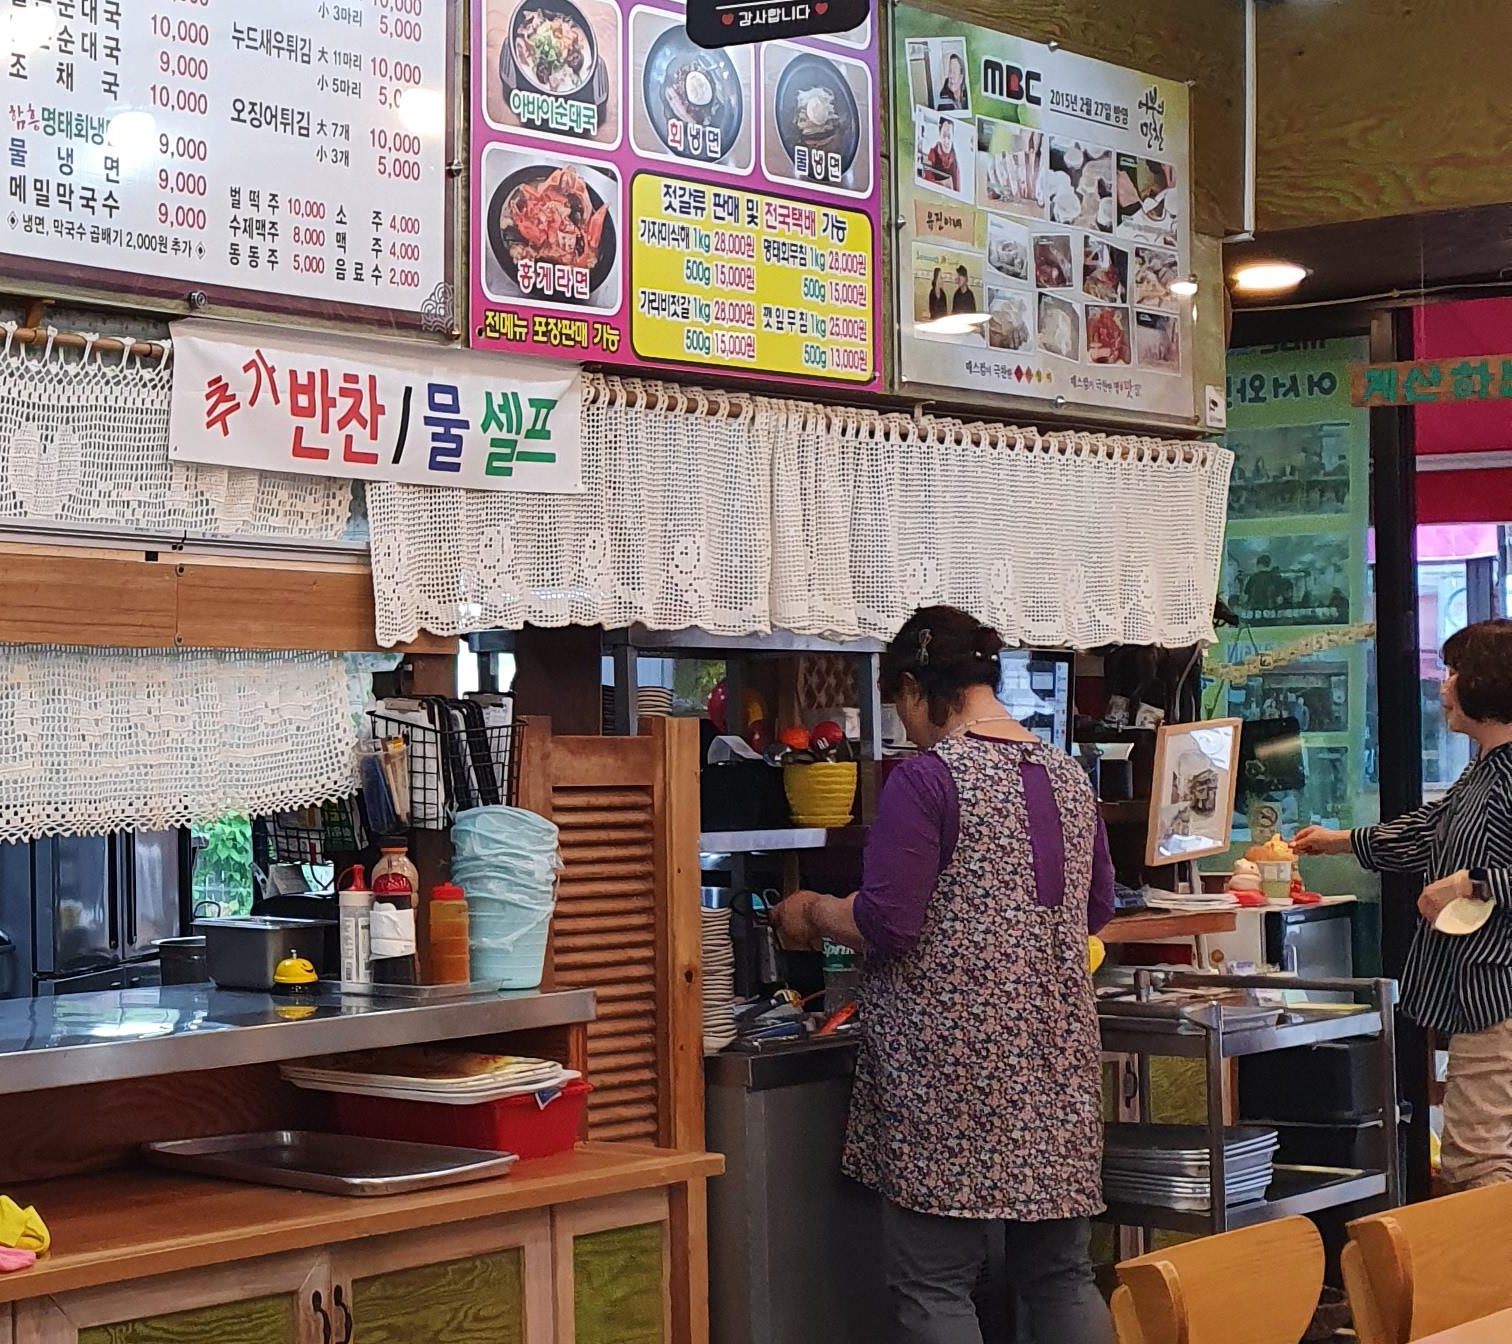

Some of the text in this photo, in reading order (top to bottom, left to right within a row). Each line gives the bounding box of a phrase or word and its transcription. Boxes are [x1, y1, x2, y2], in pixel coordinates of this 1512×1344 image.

[151, 14, 209, 46] 10,000
[333, 7, 422, 42] 3마리 5,000
[738, 4, 811, 27] 감사합니다
[159, 51, 208, 81] 9,000
[231, 21, 422, 86] 누드새우튀김 10,000
[149, 83, 208, 115] 10,000
[332, 79, 362, 99] 5마리
[982, 58, 1044, 107] MBC
[1049, 89, 1078, 112] 2015년
[230, 97, 421, 157] 오징어튀김 10,000
[510, 87, 598, 136] 아바이순대국
[40, 106, 207, 162] 명태회냉 9,000
[667, 120, 722, 158] 회냉면
[378, 156, 421, 181] 5,000
[793, 146, 843, 182] 물냉면
[158, 168, 207, 197] 9,000
[158, 201, 206, 230] 9,000
[287, 198, 420, 235] 10,000 4,000
[663, 183, 848, 243] 젓갈류 판매 전국택배 가능
[53, 218, 87, 242] 막국수
[125, 231, 168, 254] 2,000원
[171, 236, 192, 259] 추가
[229, 214, 420, 262] 수제맥주 8,000 4,000
[639, 219, 755, 258] 가자미식해 1kg 28,000원
[763, 238, 807, 268] 명태회무침
[809, 246, 826, 272] 1kg
[292, 254, 325, 275] 5,000
[389, 267, 420, 288] 2,000
[518, 259, 590, 300] 홍게라면
[685, 258, 756, 291] 500g 15,000원
[639, 290, 756, 327] 가리비젓갈 28,000원
[803, 277, 867, 307] 500g 15,000원
[485, 310, 621, 352] 전메뉴 포장판매 가능
[763, 305, 867, 343] 깻잎무침 25,000원
[685, 329, 756, 359] 500g 15,000원
[804, 344, 868, 373] 500g 13,000원
[204, 348, 282, 438] 추가
[479, 389, 559, 477] 셀프
